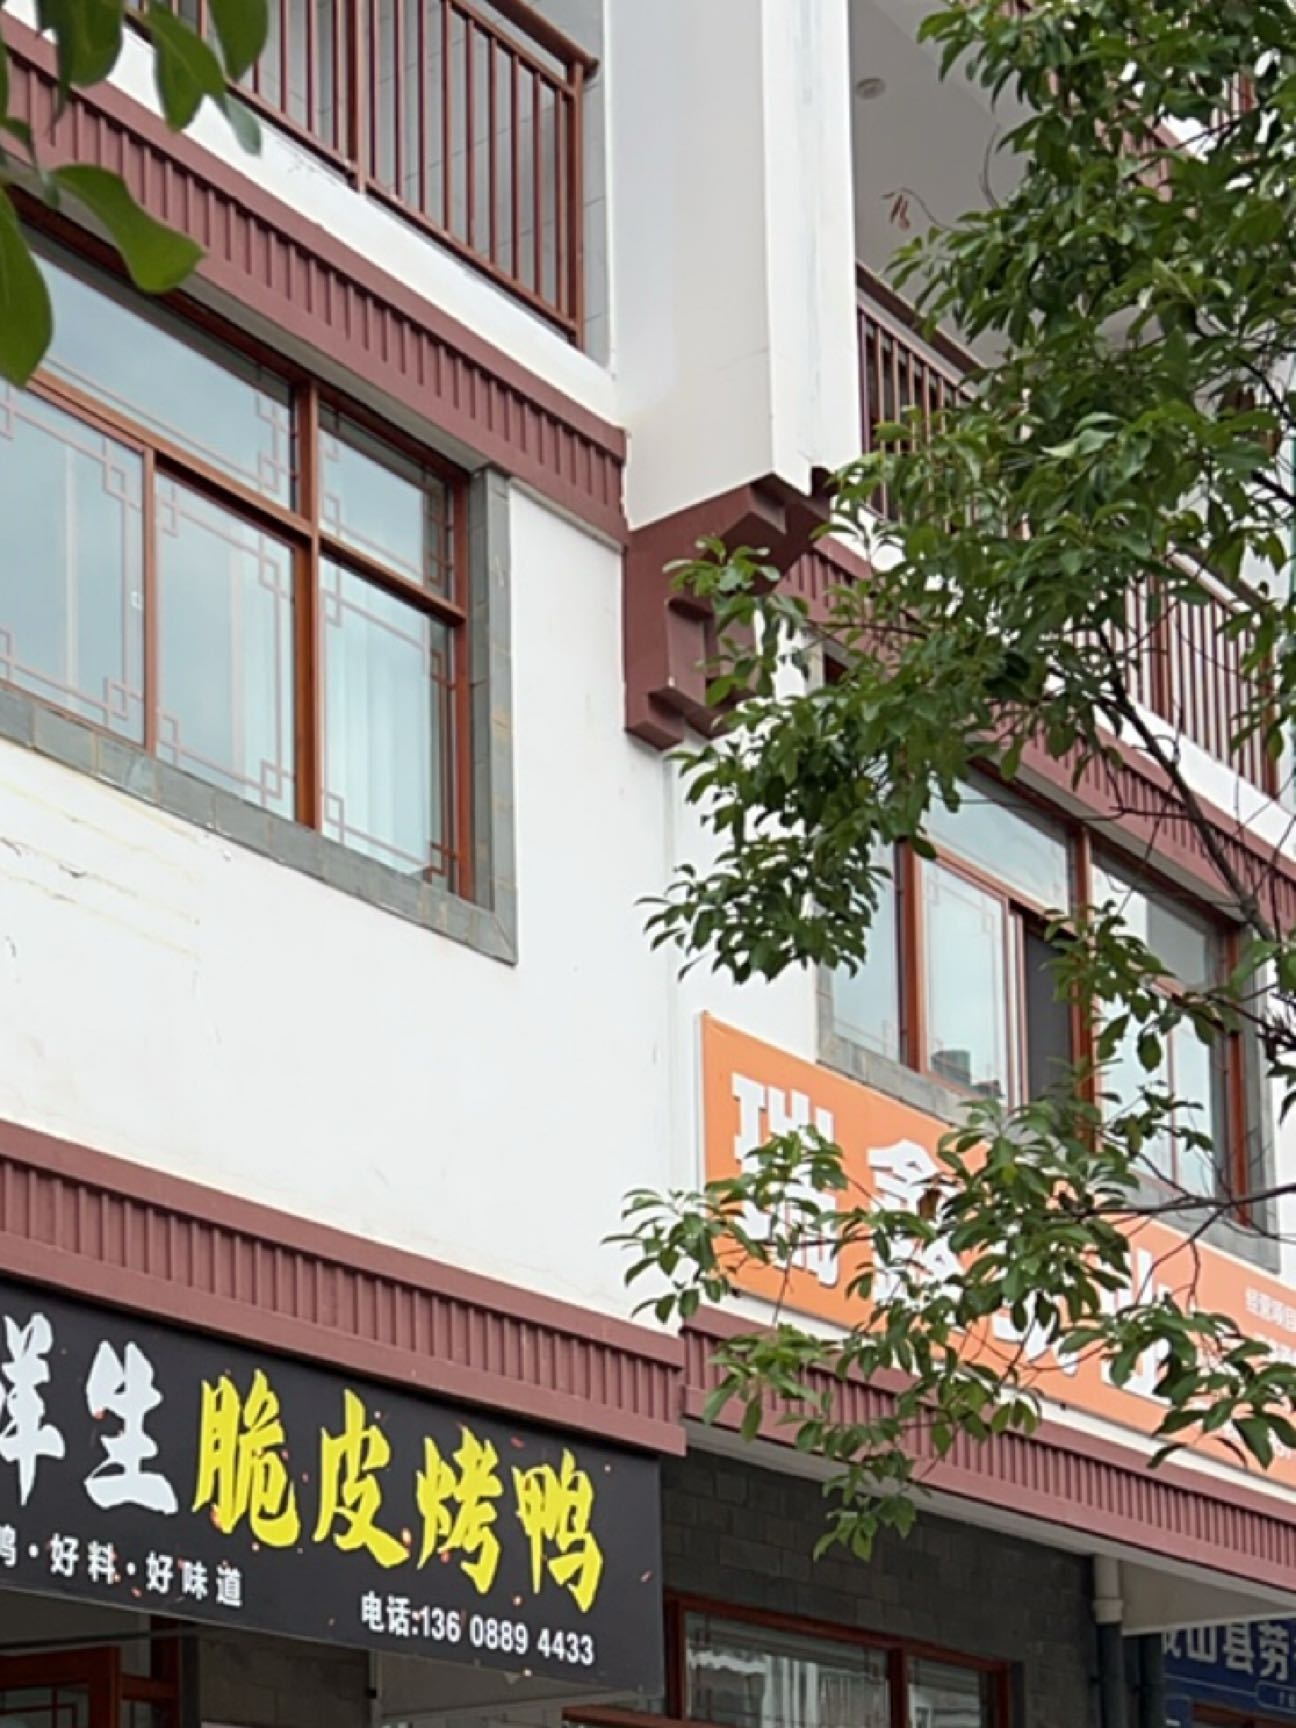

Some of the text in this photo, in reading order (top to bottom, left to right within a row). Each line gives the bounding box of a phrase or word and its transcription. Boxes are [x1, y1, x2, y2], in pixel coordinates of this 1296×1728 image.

[192, 1368, 605, 1613] 脆皮烤鸭
[360, 1591, 595, 1666] 电话:136 0889 4433
